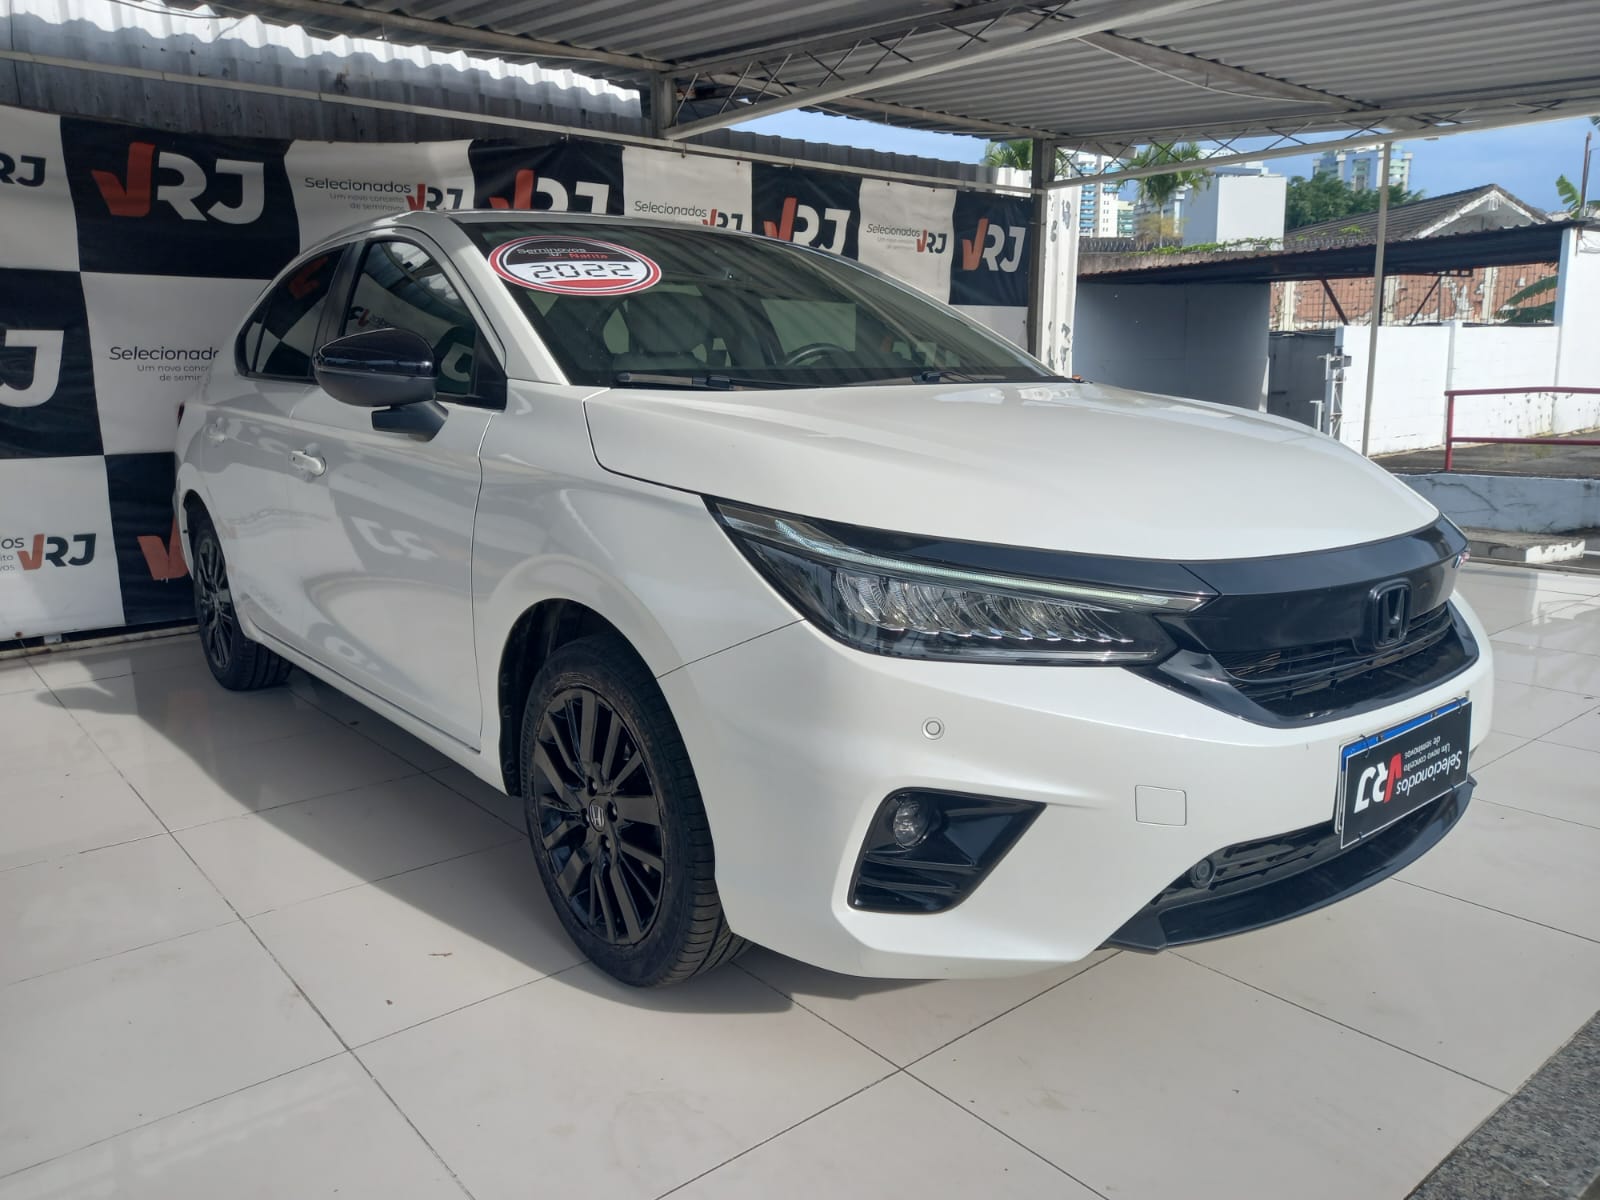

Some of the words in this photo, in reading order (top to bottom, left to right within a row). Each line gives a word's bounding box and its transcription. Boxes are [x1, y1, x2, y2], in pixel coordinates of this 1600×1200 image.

[91, 141, 265, 225] VRJ
[304, 177, 412, 193] Selecionados
[634, 200, 708, 218] Selecionados
[866, 223, 921, 238] Selecionados
[916, 229, 948, 254] VRJ
[961, 218, 1026, 273] VRJ
[530, 263, 634, 279] 2022
[0, 537, 25, 550] os
[17, 533, 97, 571] VRJ
[1353, 752, 1404, 814] VRJ
[1395, 750, 1463, 797] Selecionados
